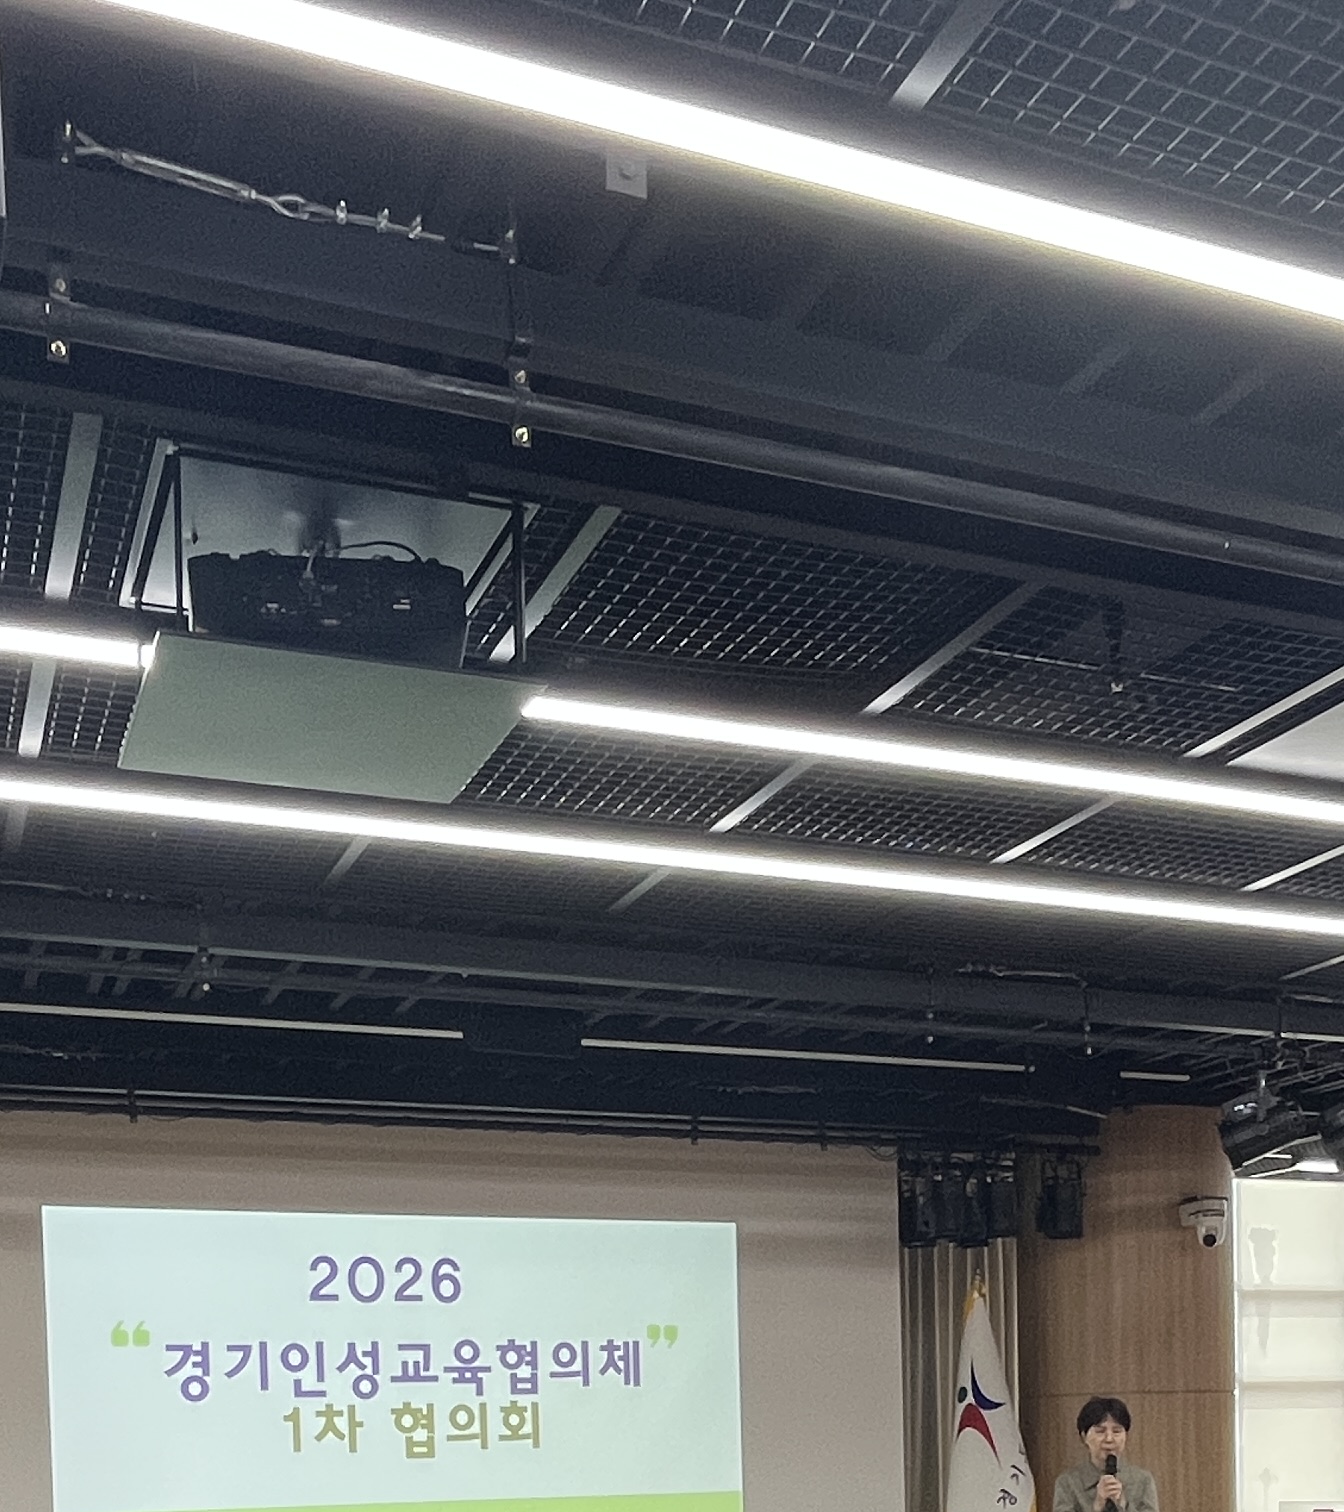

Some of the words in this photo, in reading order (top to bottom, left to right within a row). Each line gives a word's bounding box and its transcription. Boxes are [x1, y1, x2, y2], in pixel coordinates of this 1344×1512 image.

[309, 1255, 462, 1304] 2026
[282, 1403, 364, 1453] 1차
[390, 1400, 541, 1460] 협의회
